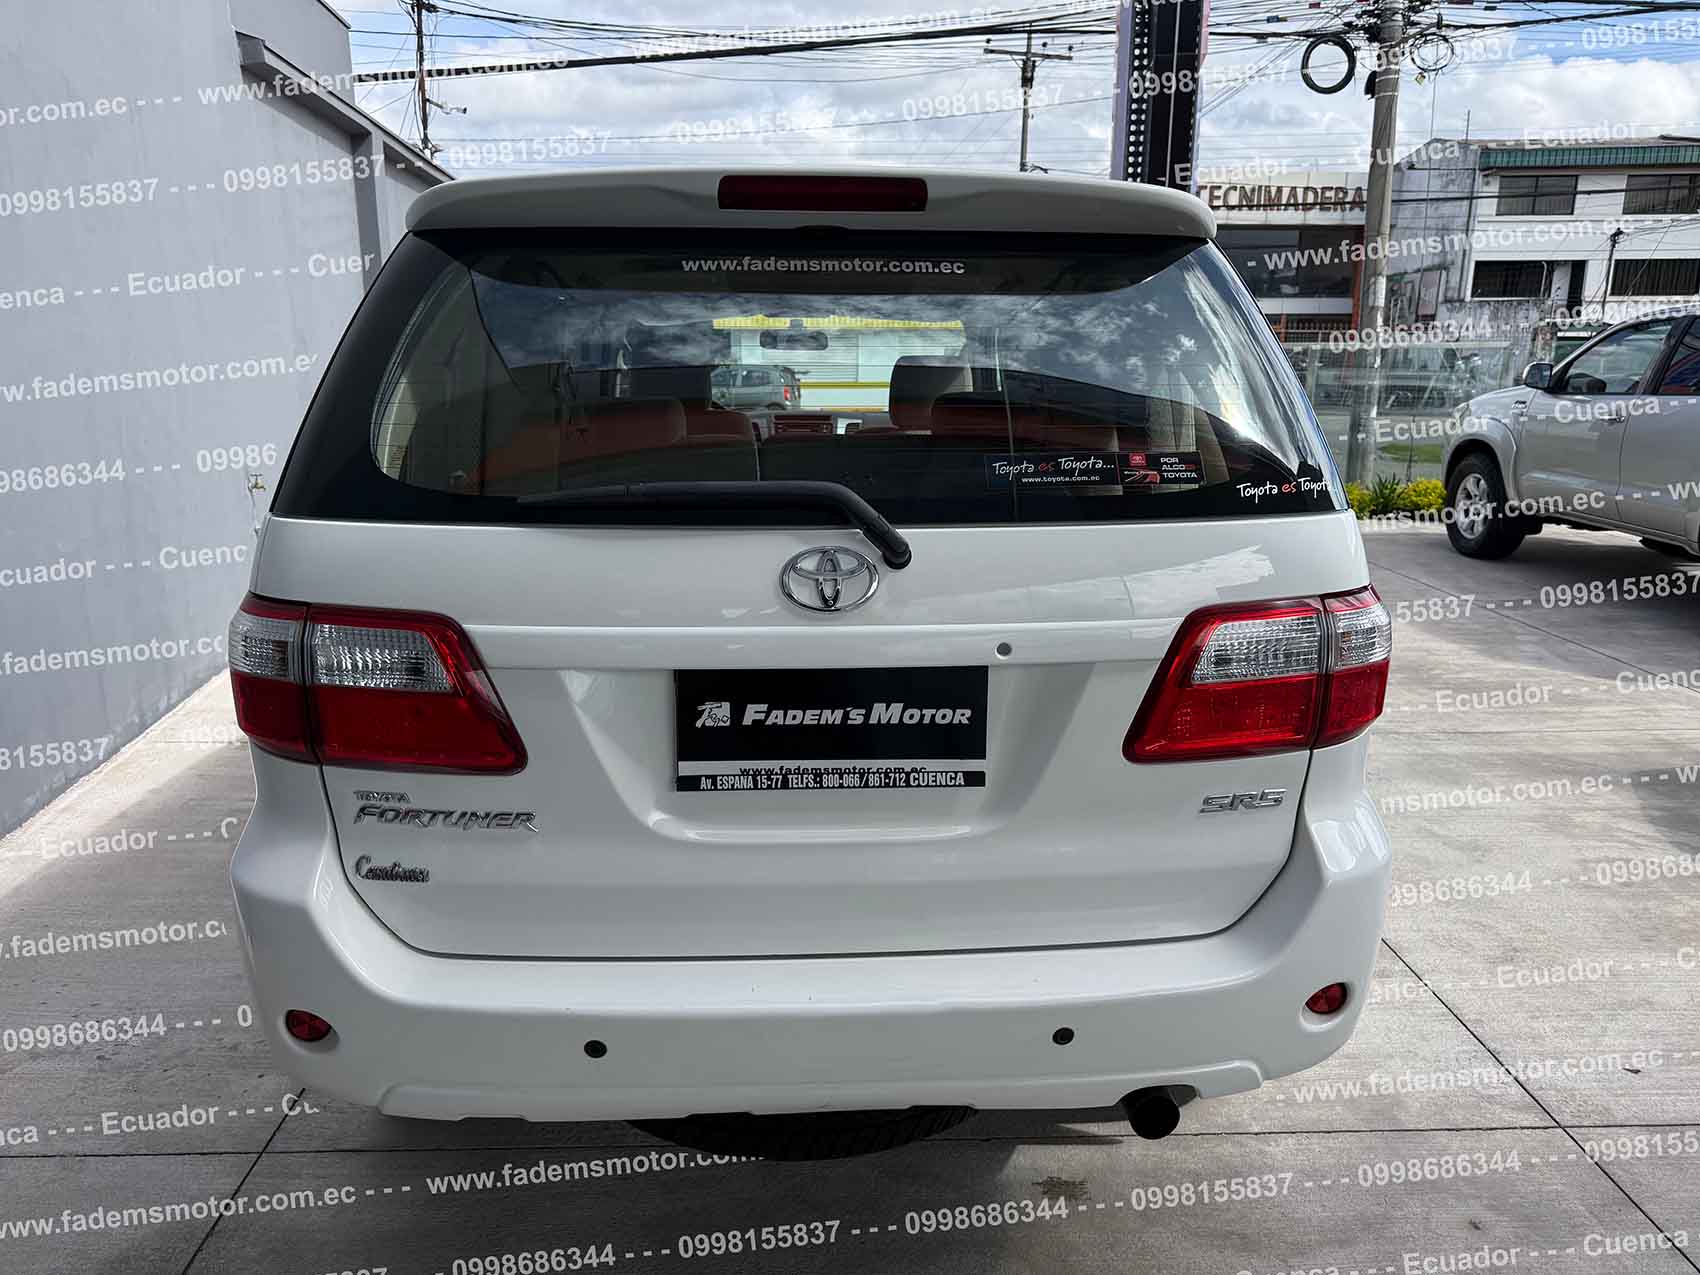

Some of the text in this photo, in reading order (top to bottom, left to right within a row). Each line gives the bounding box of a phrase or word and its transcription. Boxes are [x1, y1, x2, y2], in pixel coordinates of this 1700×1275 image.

[1196, 184, 1365, 213] TECNIMADERA
[681, 257, 966, 275] www.fademsmotor.com.ec
[992, 460, 1034, 480] Toyota
[1163, 471, 1198, 479] TOYOTA
[1236, 482, 1279, 503] Toyota
[1281, 481, 1297, 494] es
[868, 702, 972, 725] MOTOR
[757, 775, 783, 789] 15-77
[910, 772, 965, 786] CUENCA
[1199, 787, 1287, 814] SR5
[354, 804, 539, 832] FORTUNER
